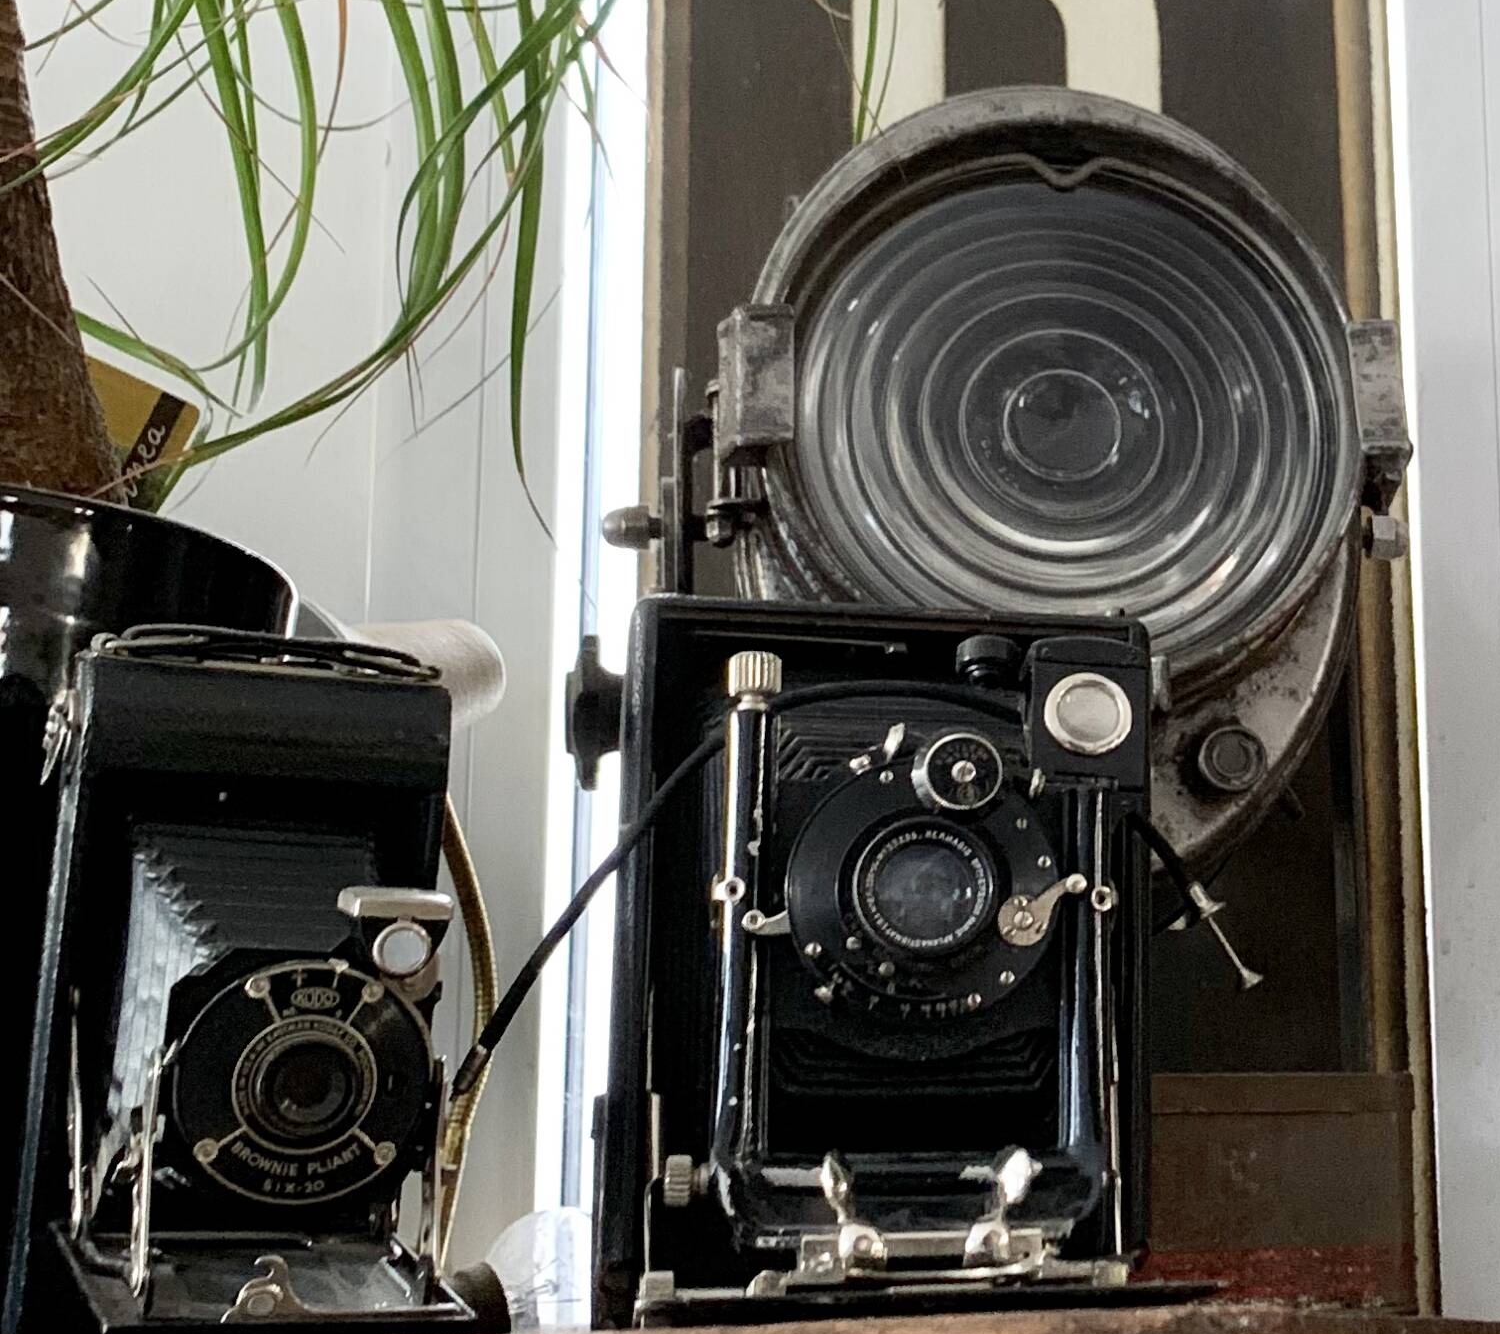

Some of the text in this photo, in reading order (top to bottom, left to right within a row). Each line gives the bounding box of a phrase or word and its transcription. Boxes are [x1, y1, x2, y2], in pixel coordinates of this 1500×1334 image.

[230, 1140, 361, 1176] BROWNIE PLIANT
[262, 1177, 325, 1194] SIX-20
